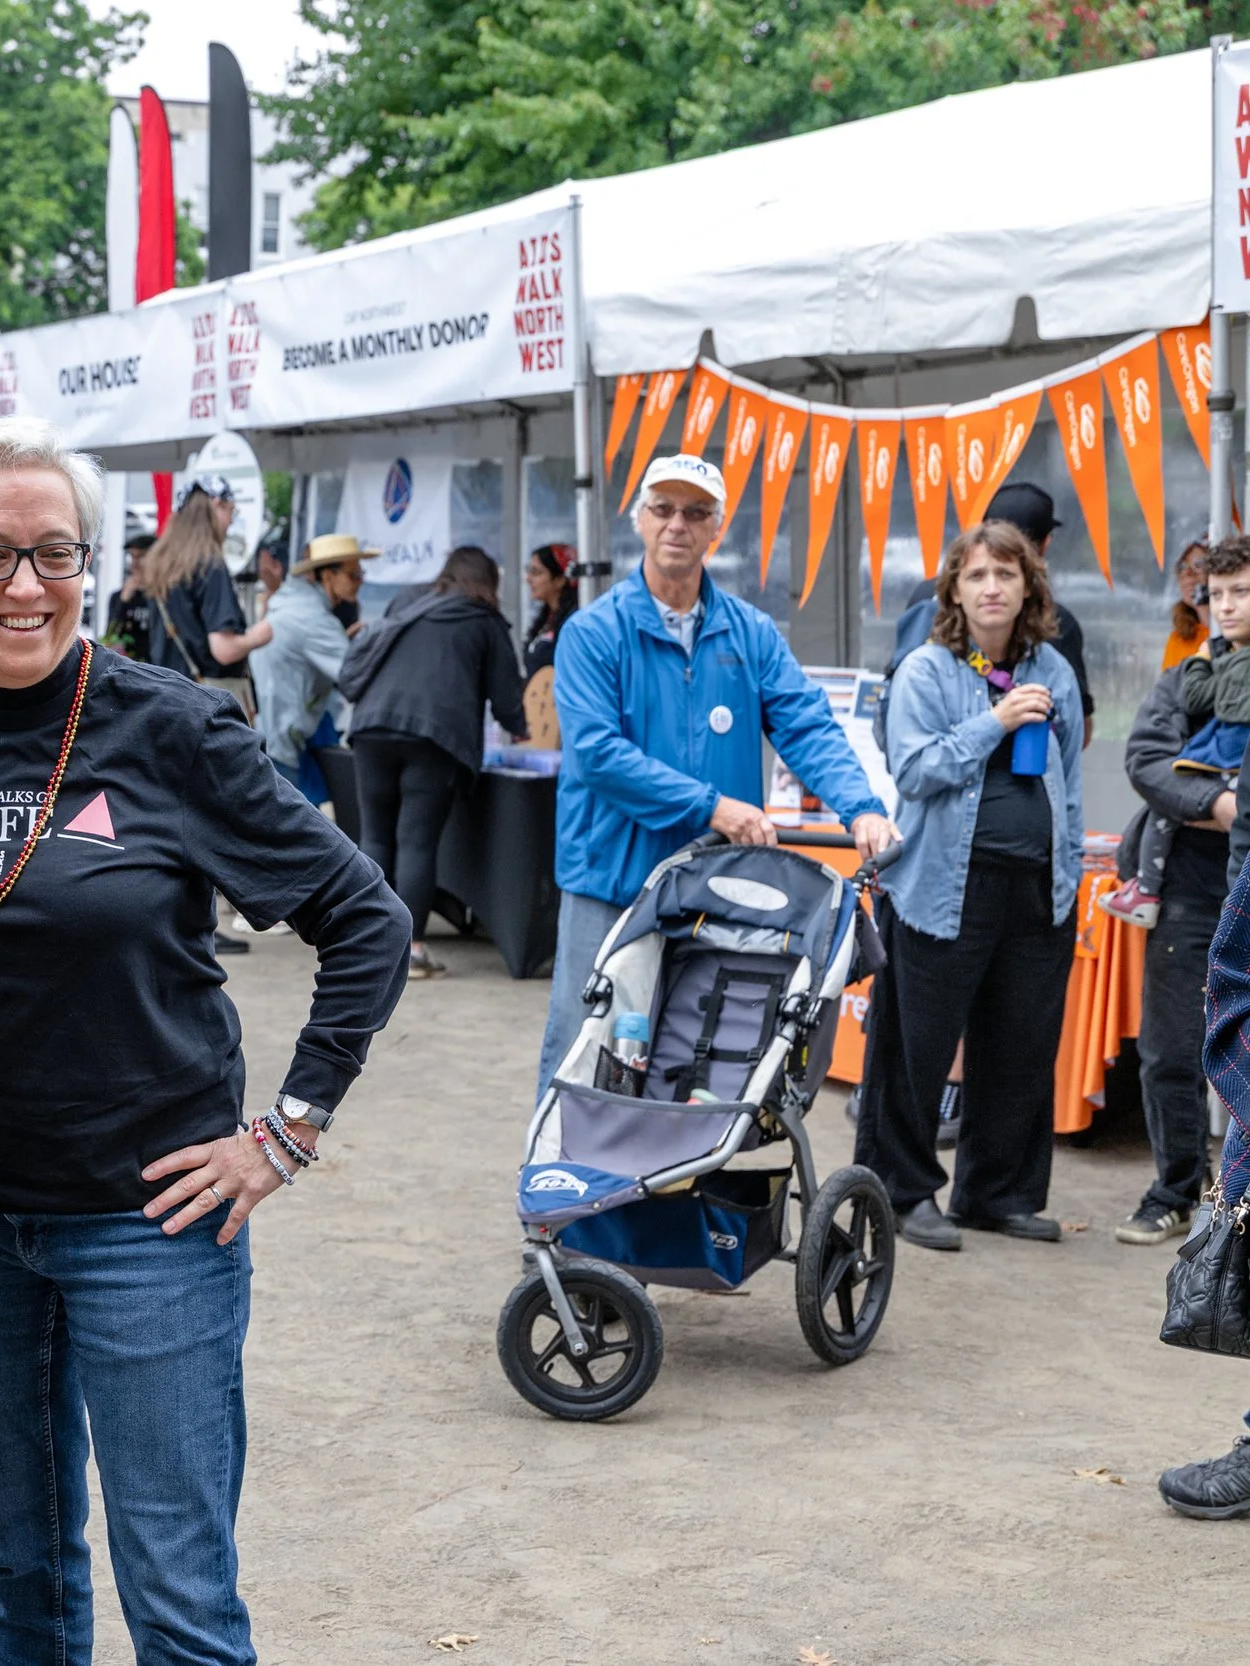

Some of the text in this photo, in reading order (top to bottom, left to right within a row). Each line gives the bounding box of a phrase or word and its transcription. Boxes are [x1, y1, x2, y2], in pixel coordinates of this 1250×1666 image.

[516, 268, 563, 304] WALK
[514, 305, 564, 337] NORTH
[282, 312, 490, 372] BECOME A MONTHLY DONOR
[518, 337, 564, 373] WEST
[59, 365, 87, 396] OUR
[90, 353, 142, 393] HOUSE
